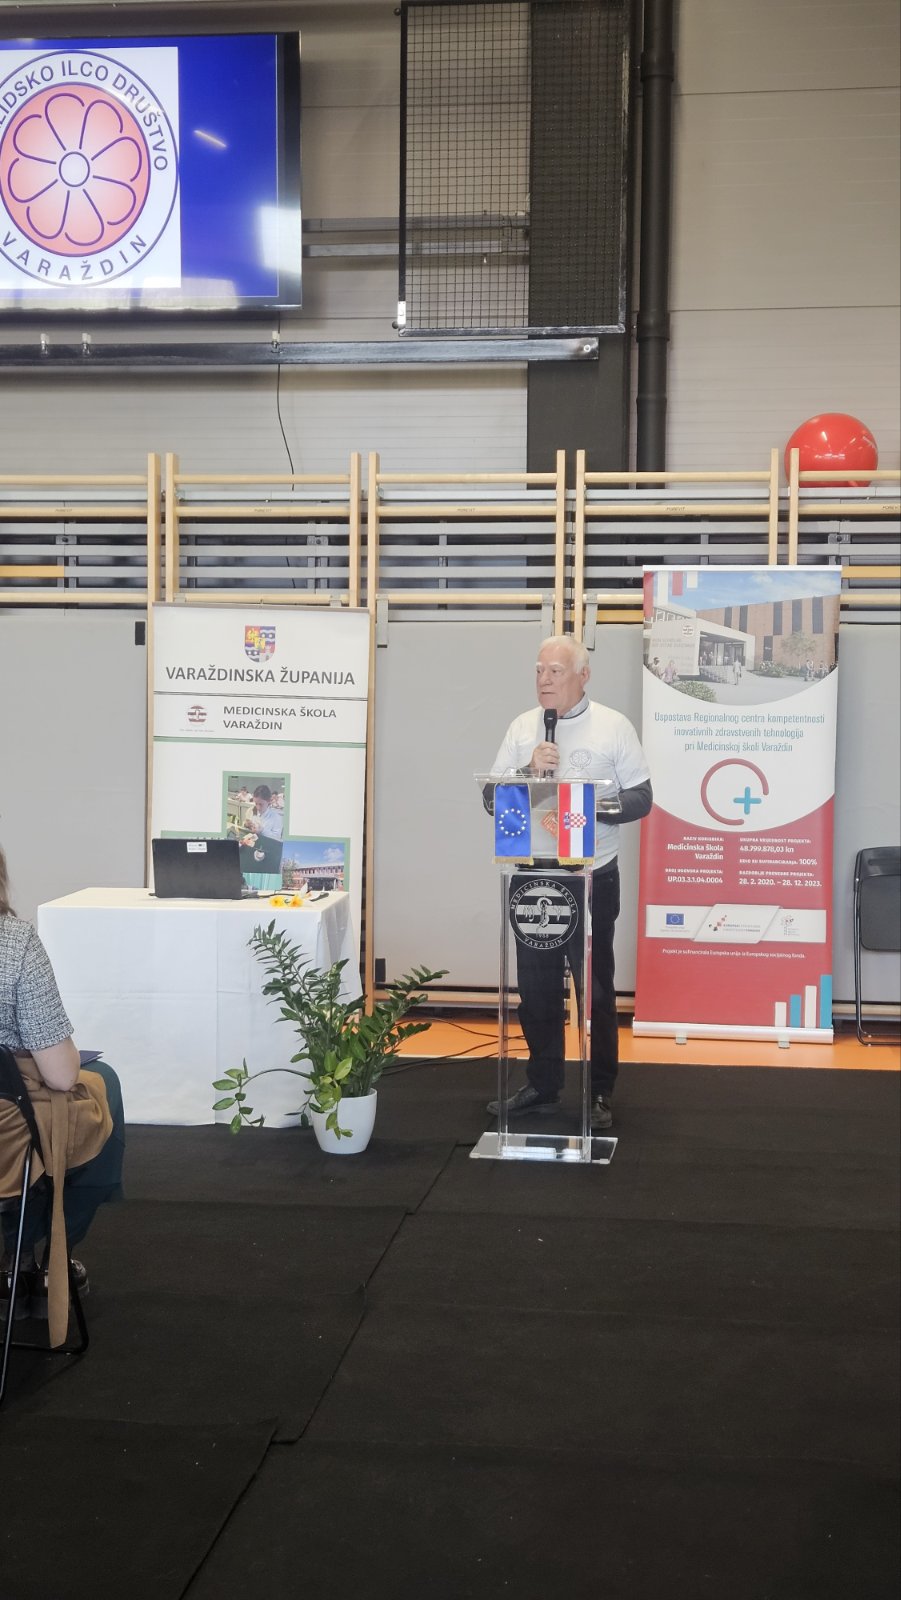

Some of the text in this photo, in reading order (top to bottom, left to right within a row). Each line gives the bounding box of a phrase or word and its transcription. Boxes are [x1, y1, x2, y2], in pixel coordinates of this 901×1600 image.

[62, 60, 109, 81] ILCO
[112, 74, 168, 171] DRUŠTVO
[2, 231, 147, 281] VARAŽDIN
[165, 665, 355, 685] VARAŽDINSKA ŽUPANIJA
[223, 705, 337, 718] MEDICINSKA ŠKOLA
[654, 712, 825, 724] Uspostava Regionalnog centra kompetentnosti
[223, 719, 283, 730] VARAŽDIN
[674, 727, 804, 739] inovativnih zdravstvenih tehnologija
[684, 741, 793, 752] pri Medicinskoj školi Varaždin
[667, 843, 705, 851] Medicinska
[695, 852, 724, 860] Varaždin
[511, 881, 556, 910] MEDICINSKA
[560, 888, 576, 914] ŠKOLA
[525, 937, 563, 947] VARAŽDIN
